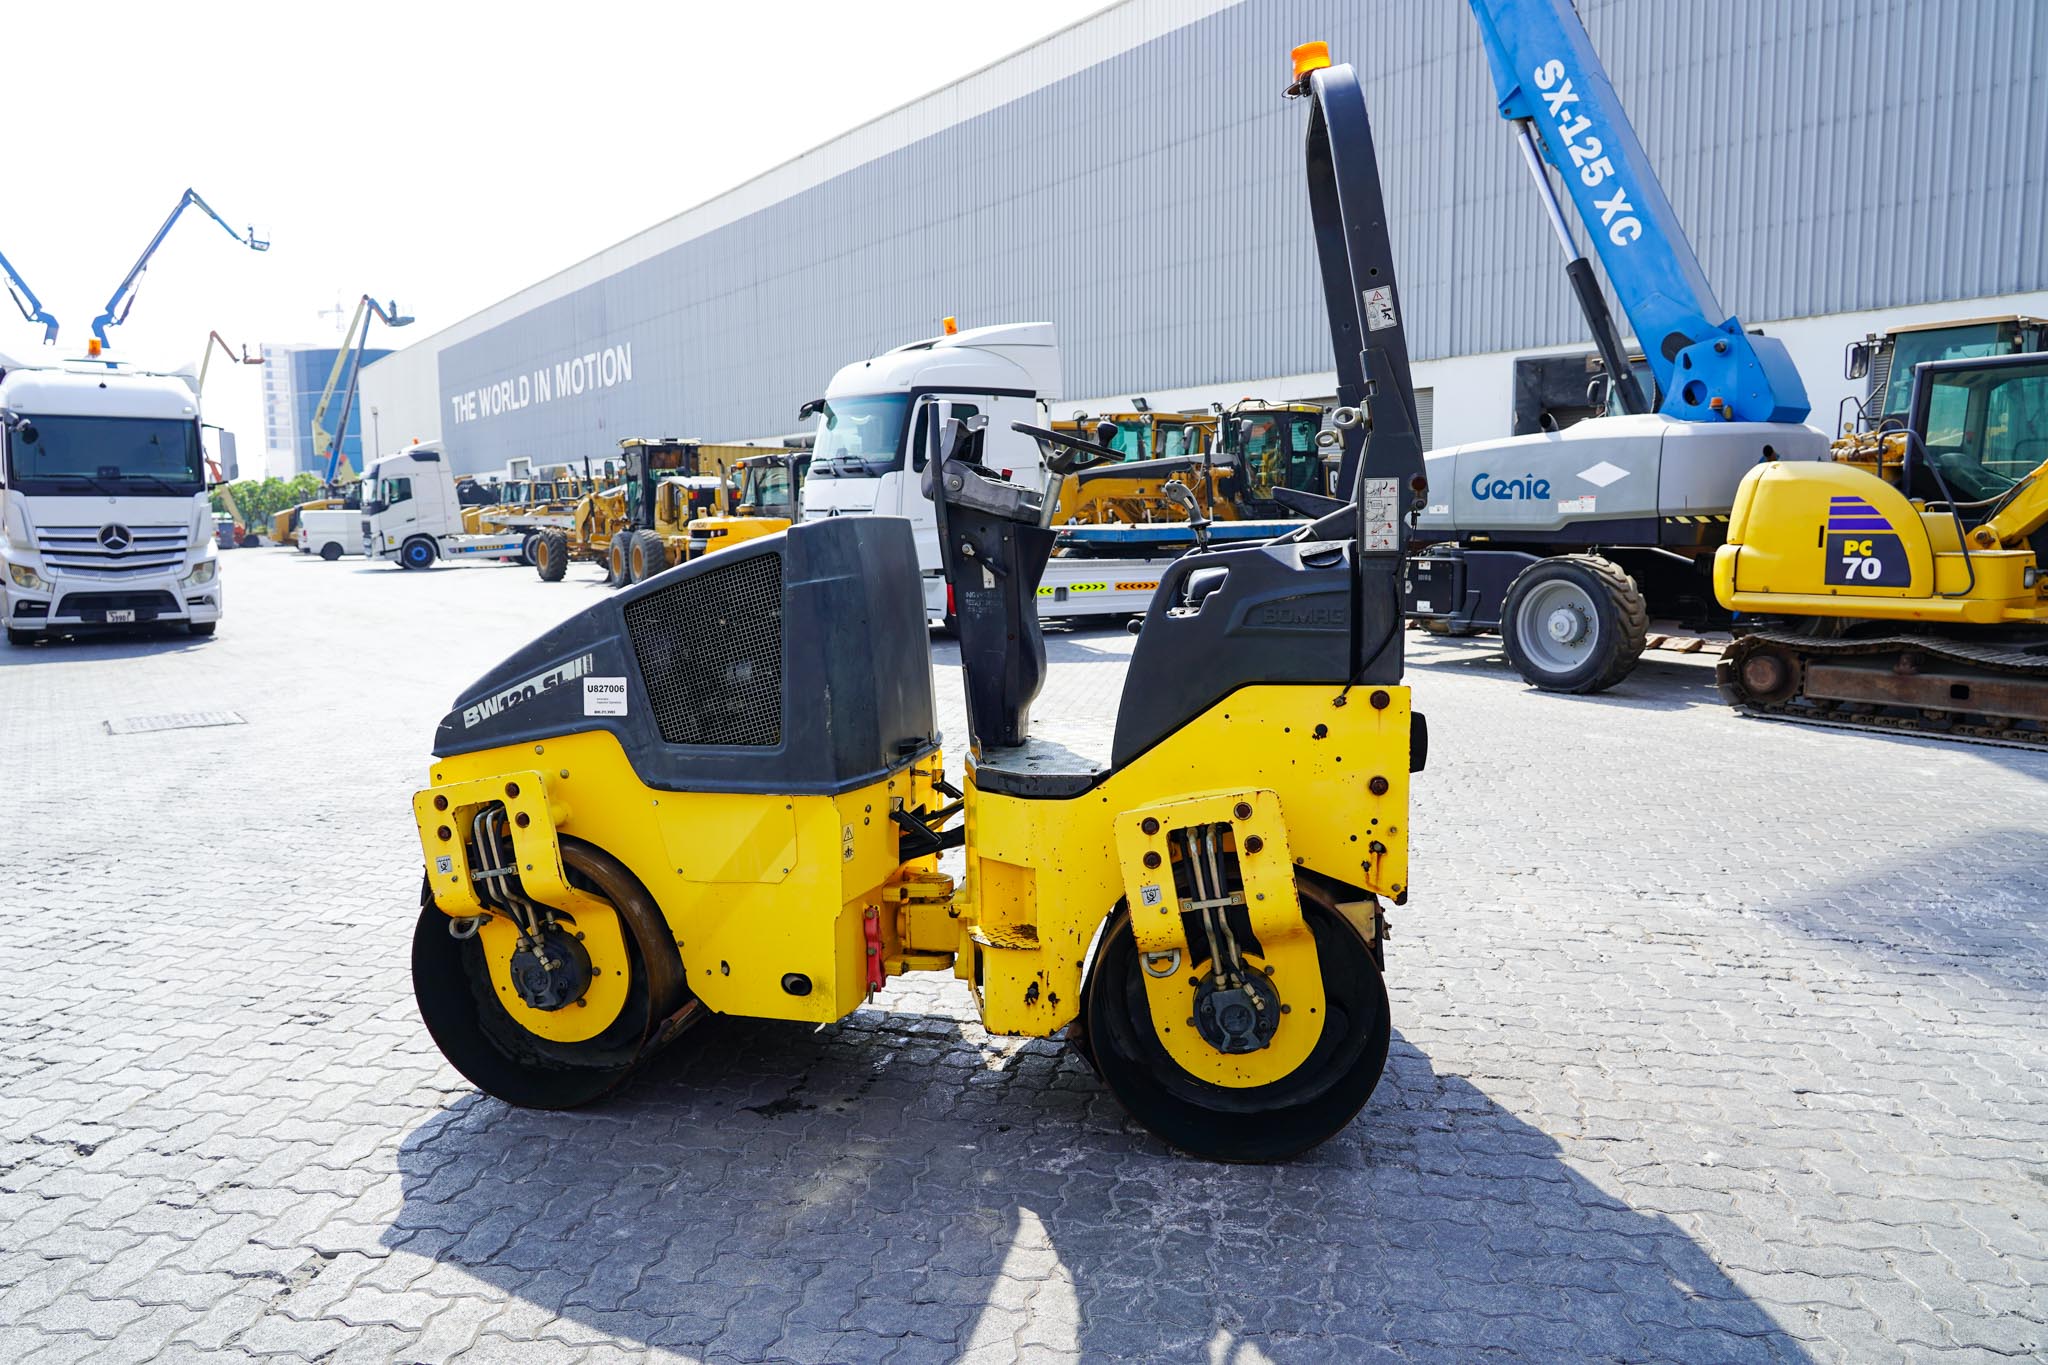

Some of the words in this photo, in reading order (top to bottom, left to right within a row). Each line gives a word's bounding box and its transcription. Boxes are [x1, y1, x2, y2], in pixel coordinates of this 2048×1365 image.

[1534, 59, 1615, 187] SX-125
[1593, 186, 1643, 247] XC
[452, 391, 477, 424] THE
[478, 375, 530, 416] WORLD
[534, 367, 551, 404] IN
[555, 342, 632, 399] MOTION
[1471, 472, 1551, 501] Genie
[1843, 539, 1873, 557] PC
[1842, 557, 1882, 580] 70
[587, 684, 625, 693] U827006
